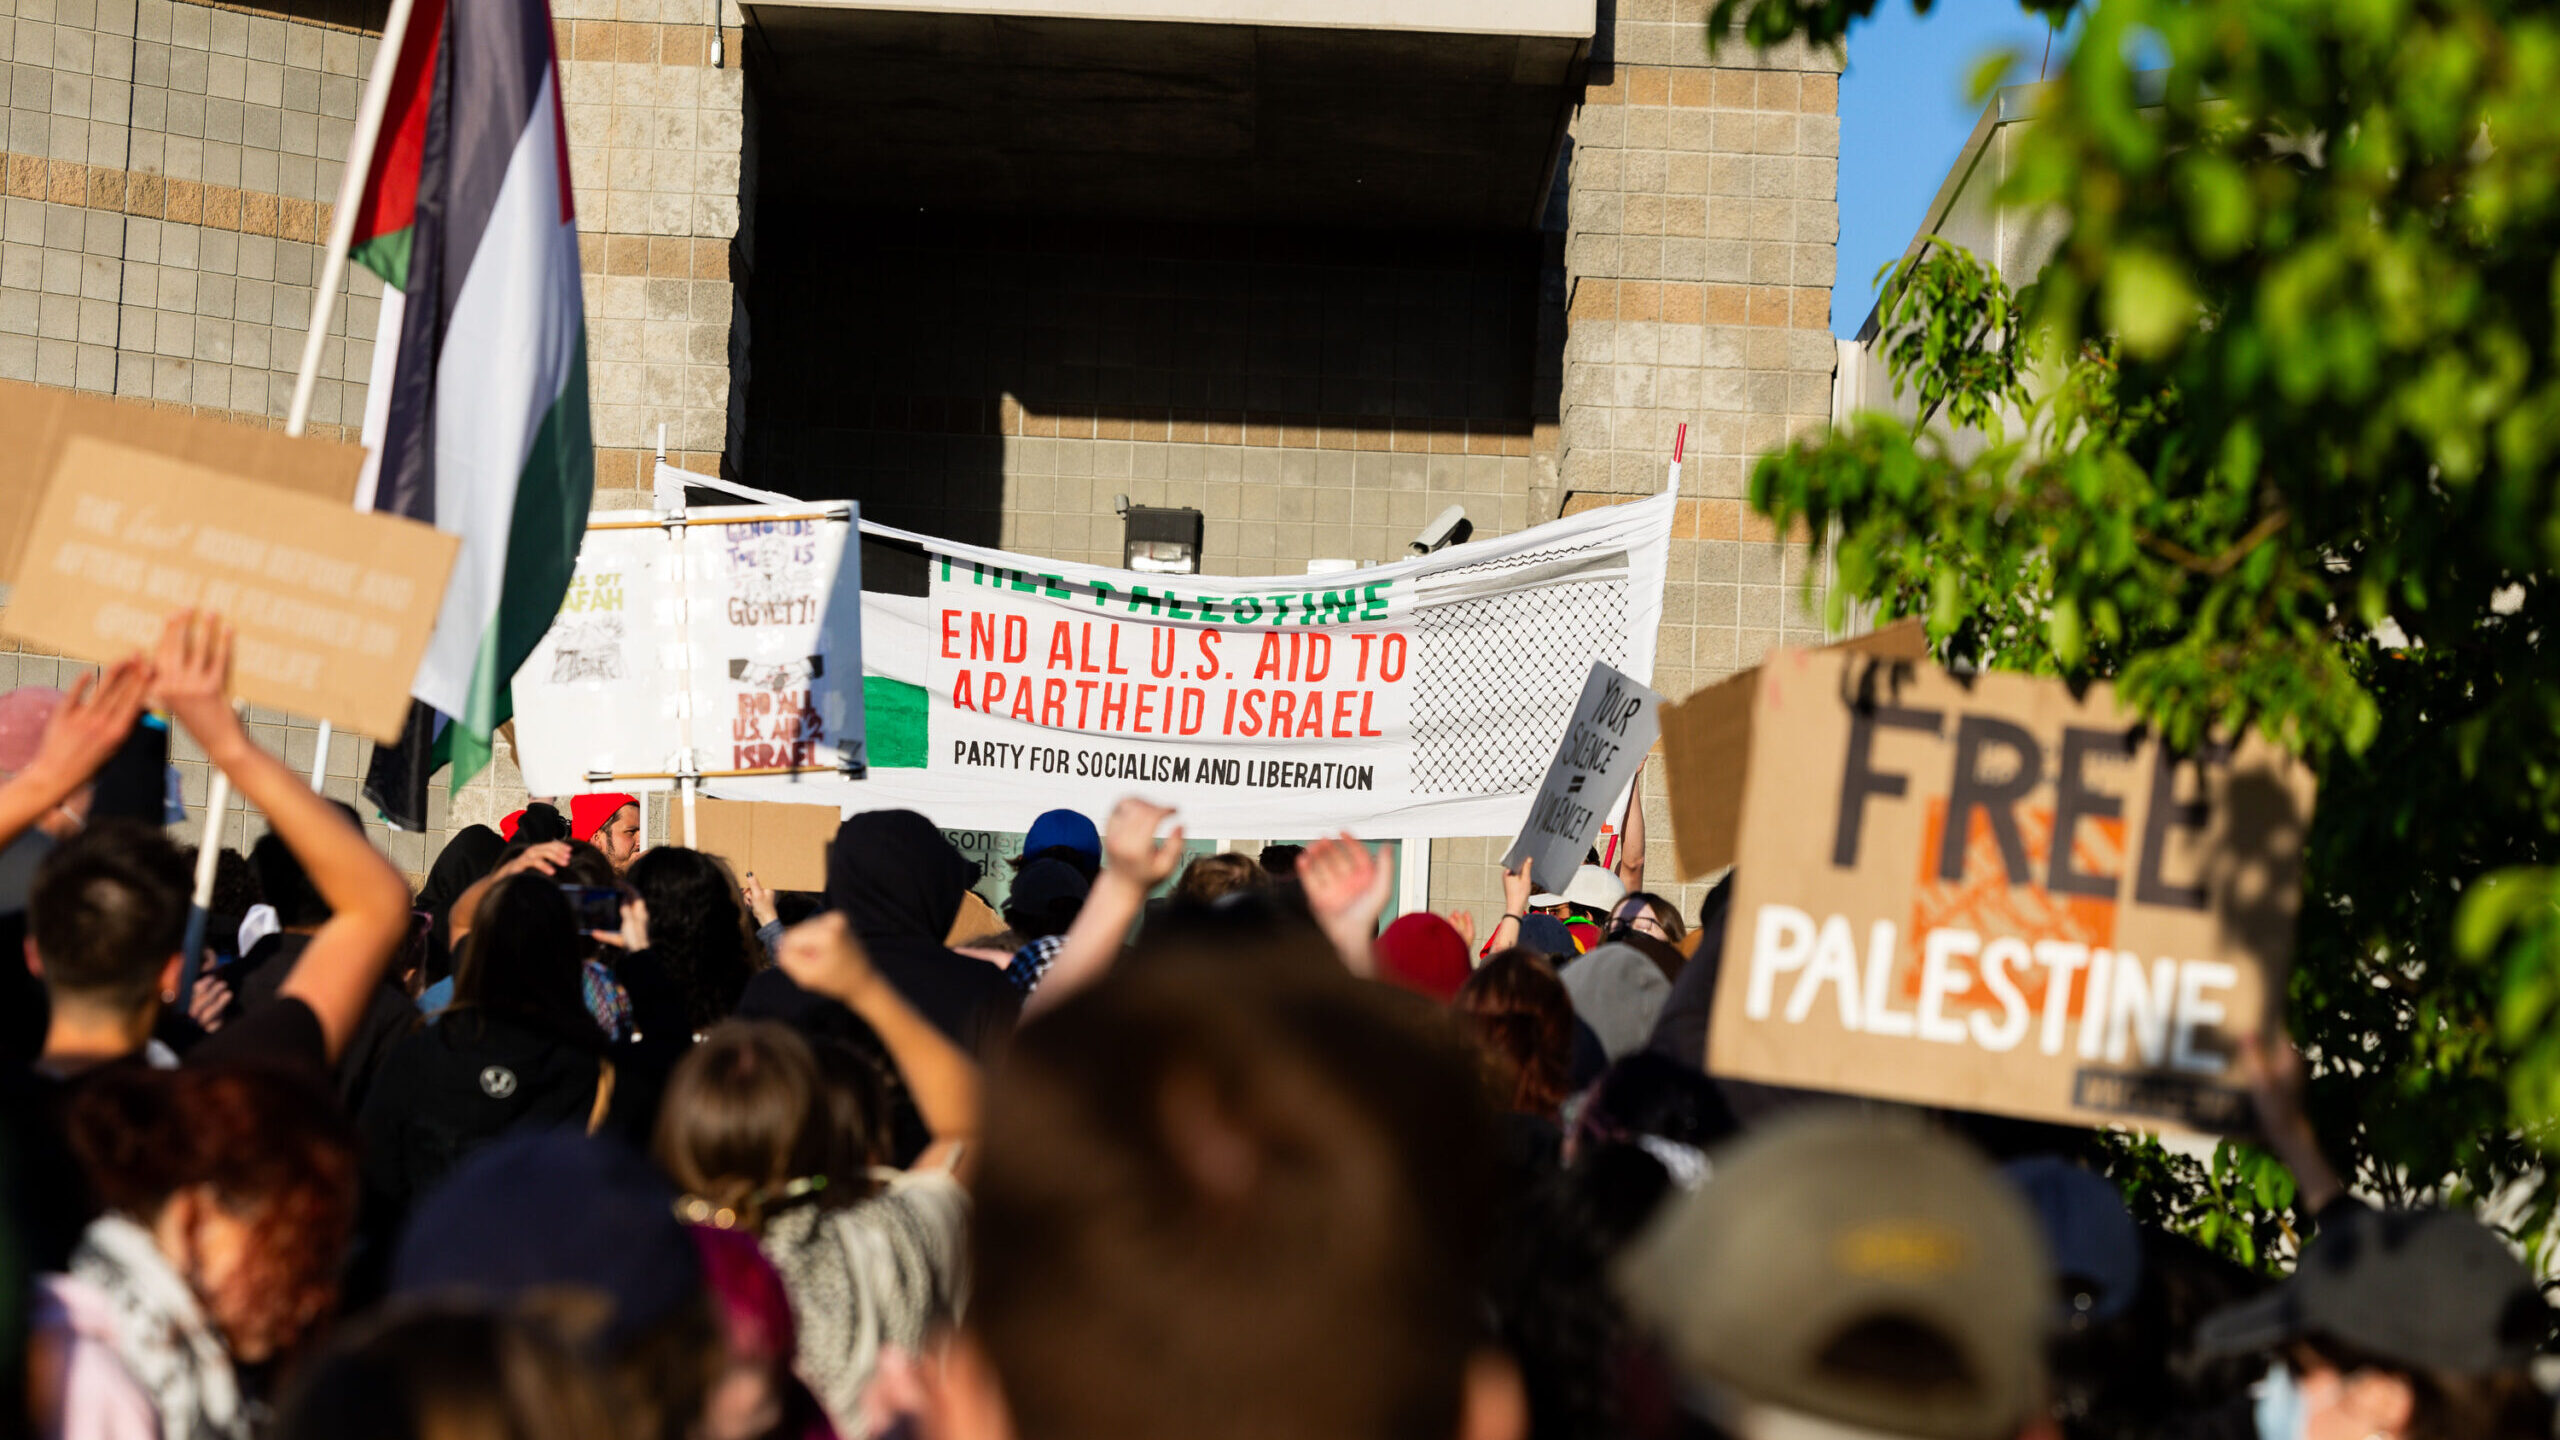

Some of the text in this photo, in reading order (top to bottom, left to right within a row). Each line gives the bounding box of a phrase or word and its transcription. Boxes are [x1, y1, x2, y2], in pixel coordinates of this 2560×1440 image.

[561, 587, 623, 614] AFAH
[941, 609, 1407, 683] END ALL U.S. AID TO
[953, 669, 1382, 738] APARTHEID ISRAEL
[1591, 677, 1641, 737] YOUR
[733, 742, 824, 769] ISRAEL
[954, 740, 1374, 791] PARTY FOR SOCIALISM AND LIBERATION
[1563, 721, 1619, 775] SILENCE
[1832, 704, 2214, 911] FREE
[1744, 905, 2238, 1074] PALESTINE
